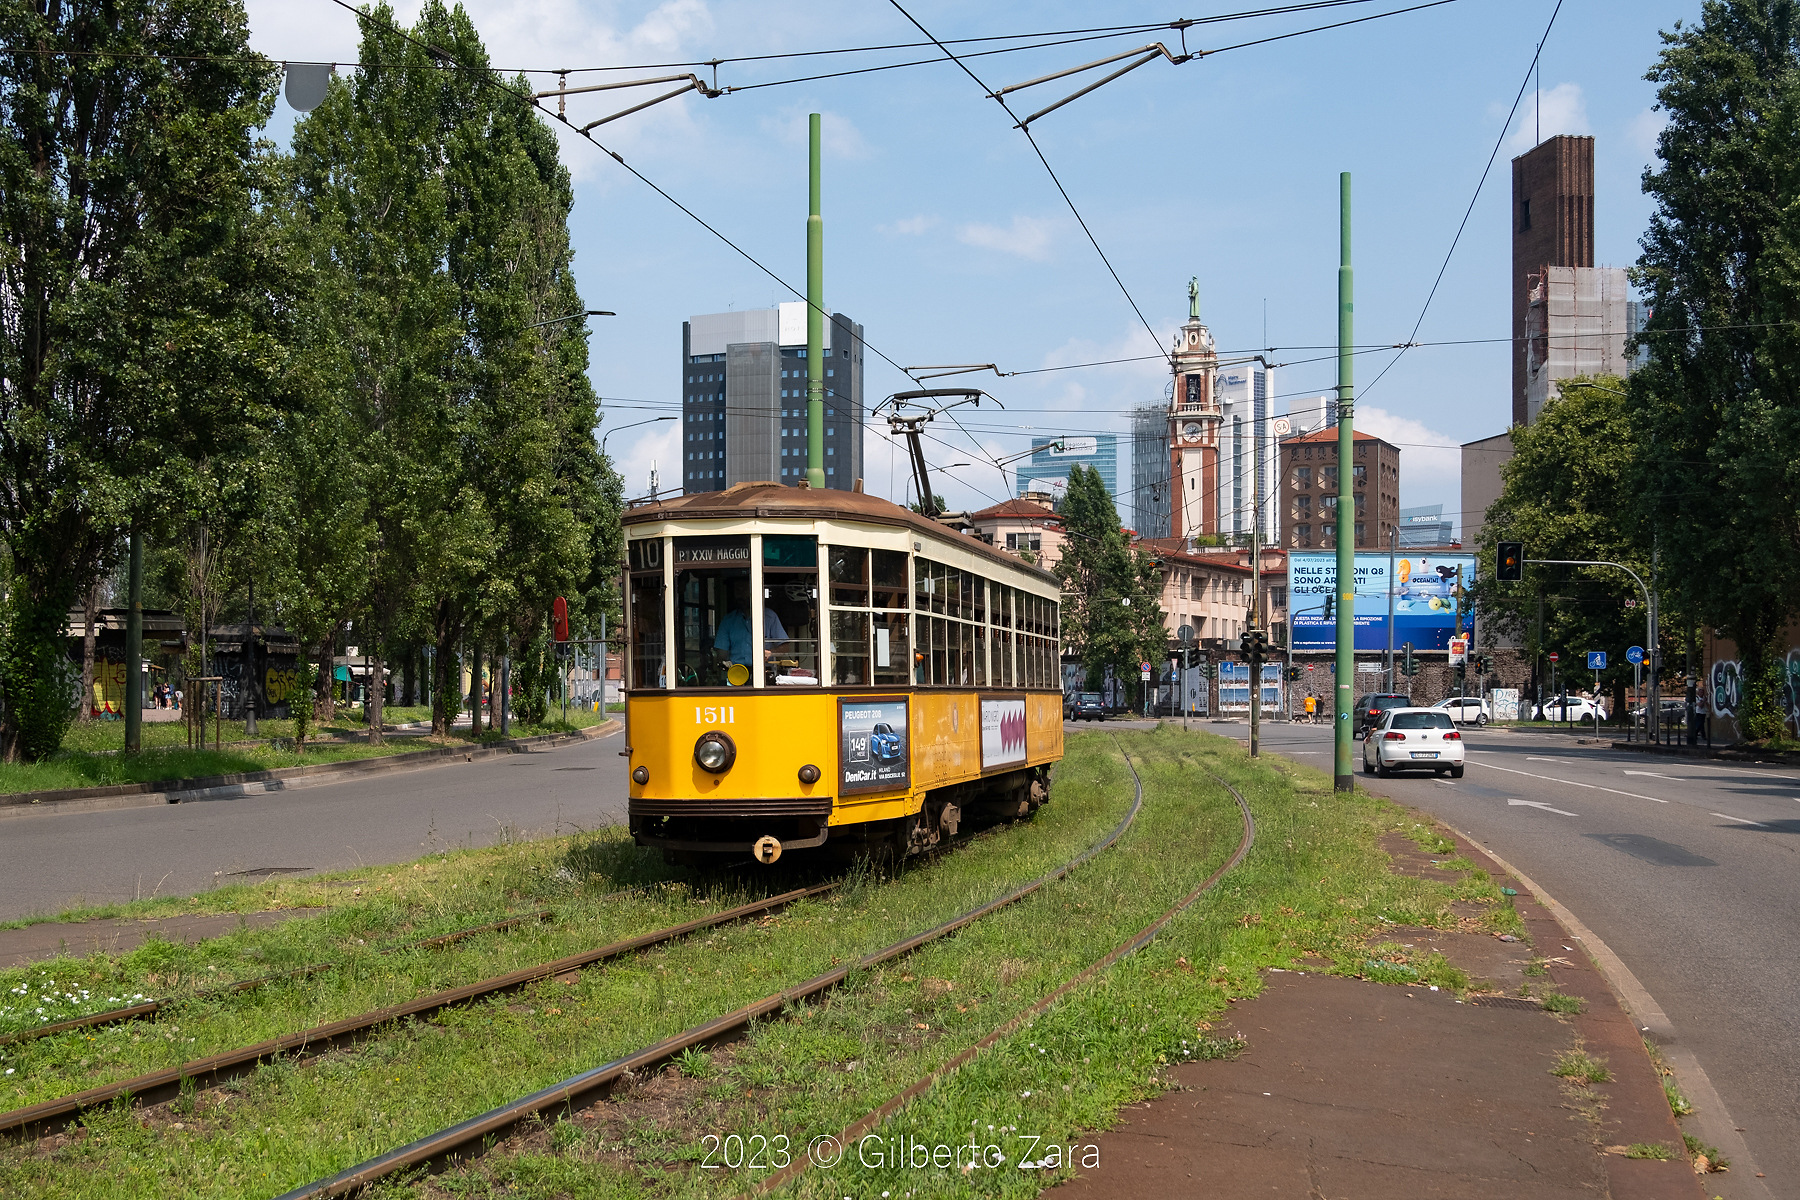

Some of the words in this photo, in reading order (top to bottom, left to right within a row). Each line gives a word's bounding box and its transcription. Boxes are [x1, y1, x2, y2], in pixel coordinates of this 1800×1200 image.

[640, 540, 659, 568] 10
[692, 550, 713, 560] XXIV
[717, 548, 748, 560] MAGGIO
[696, 706, 734, 724] 1511
[845, 710, 871, 719] PEUGEOT
[872, 710, 882, 718] 208
[845, 770, 876, 782] DeniCar.it
